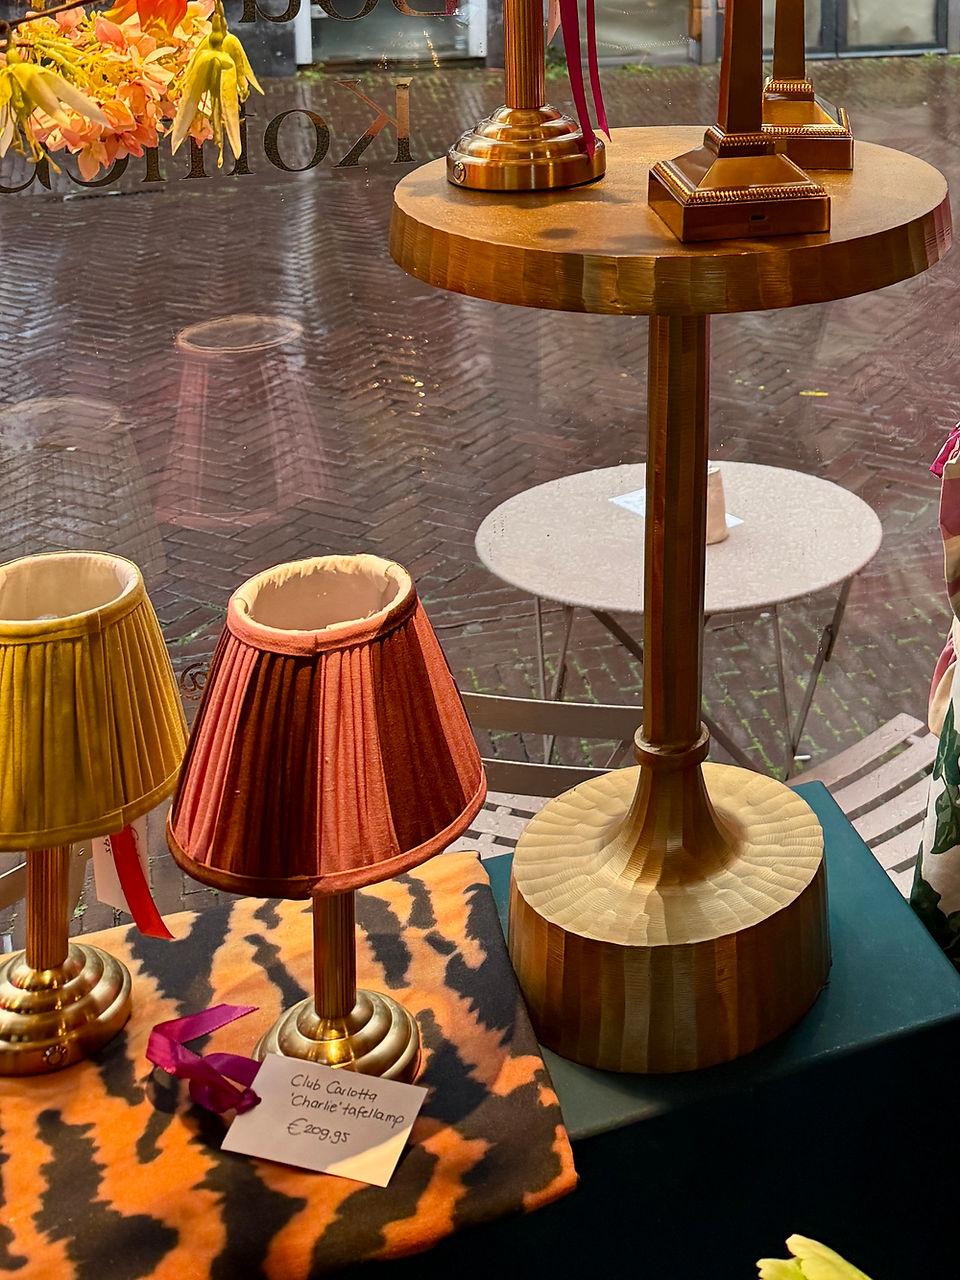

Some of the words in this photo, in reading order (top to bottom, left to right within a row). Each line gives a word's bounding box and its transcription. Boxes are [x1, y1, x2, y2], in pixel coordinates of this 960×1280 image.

[290, 1073, 321, 1091] Club
[326, 1080, 378, 1103] Carlotta
[343, 1102, 406, 1129] tafellamp
